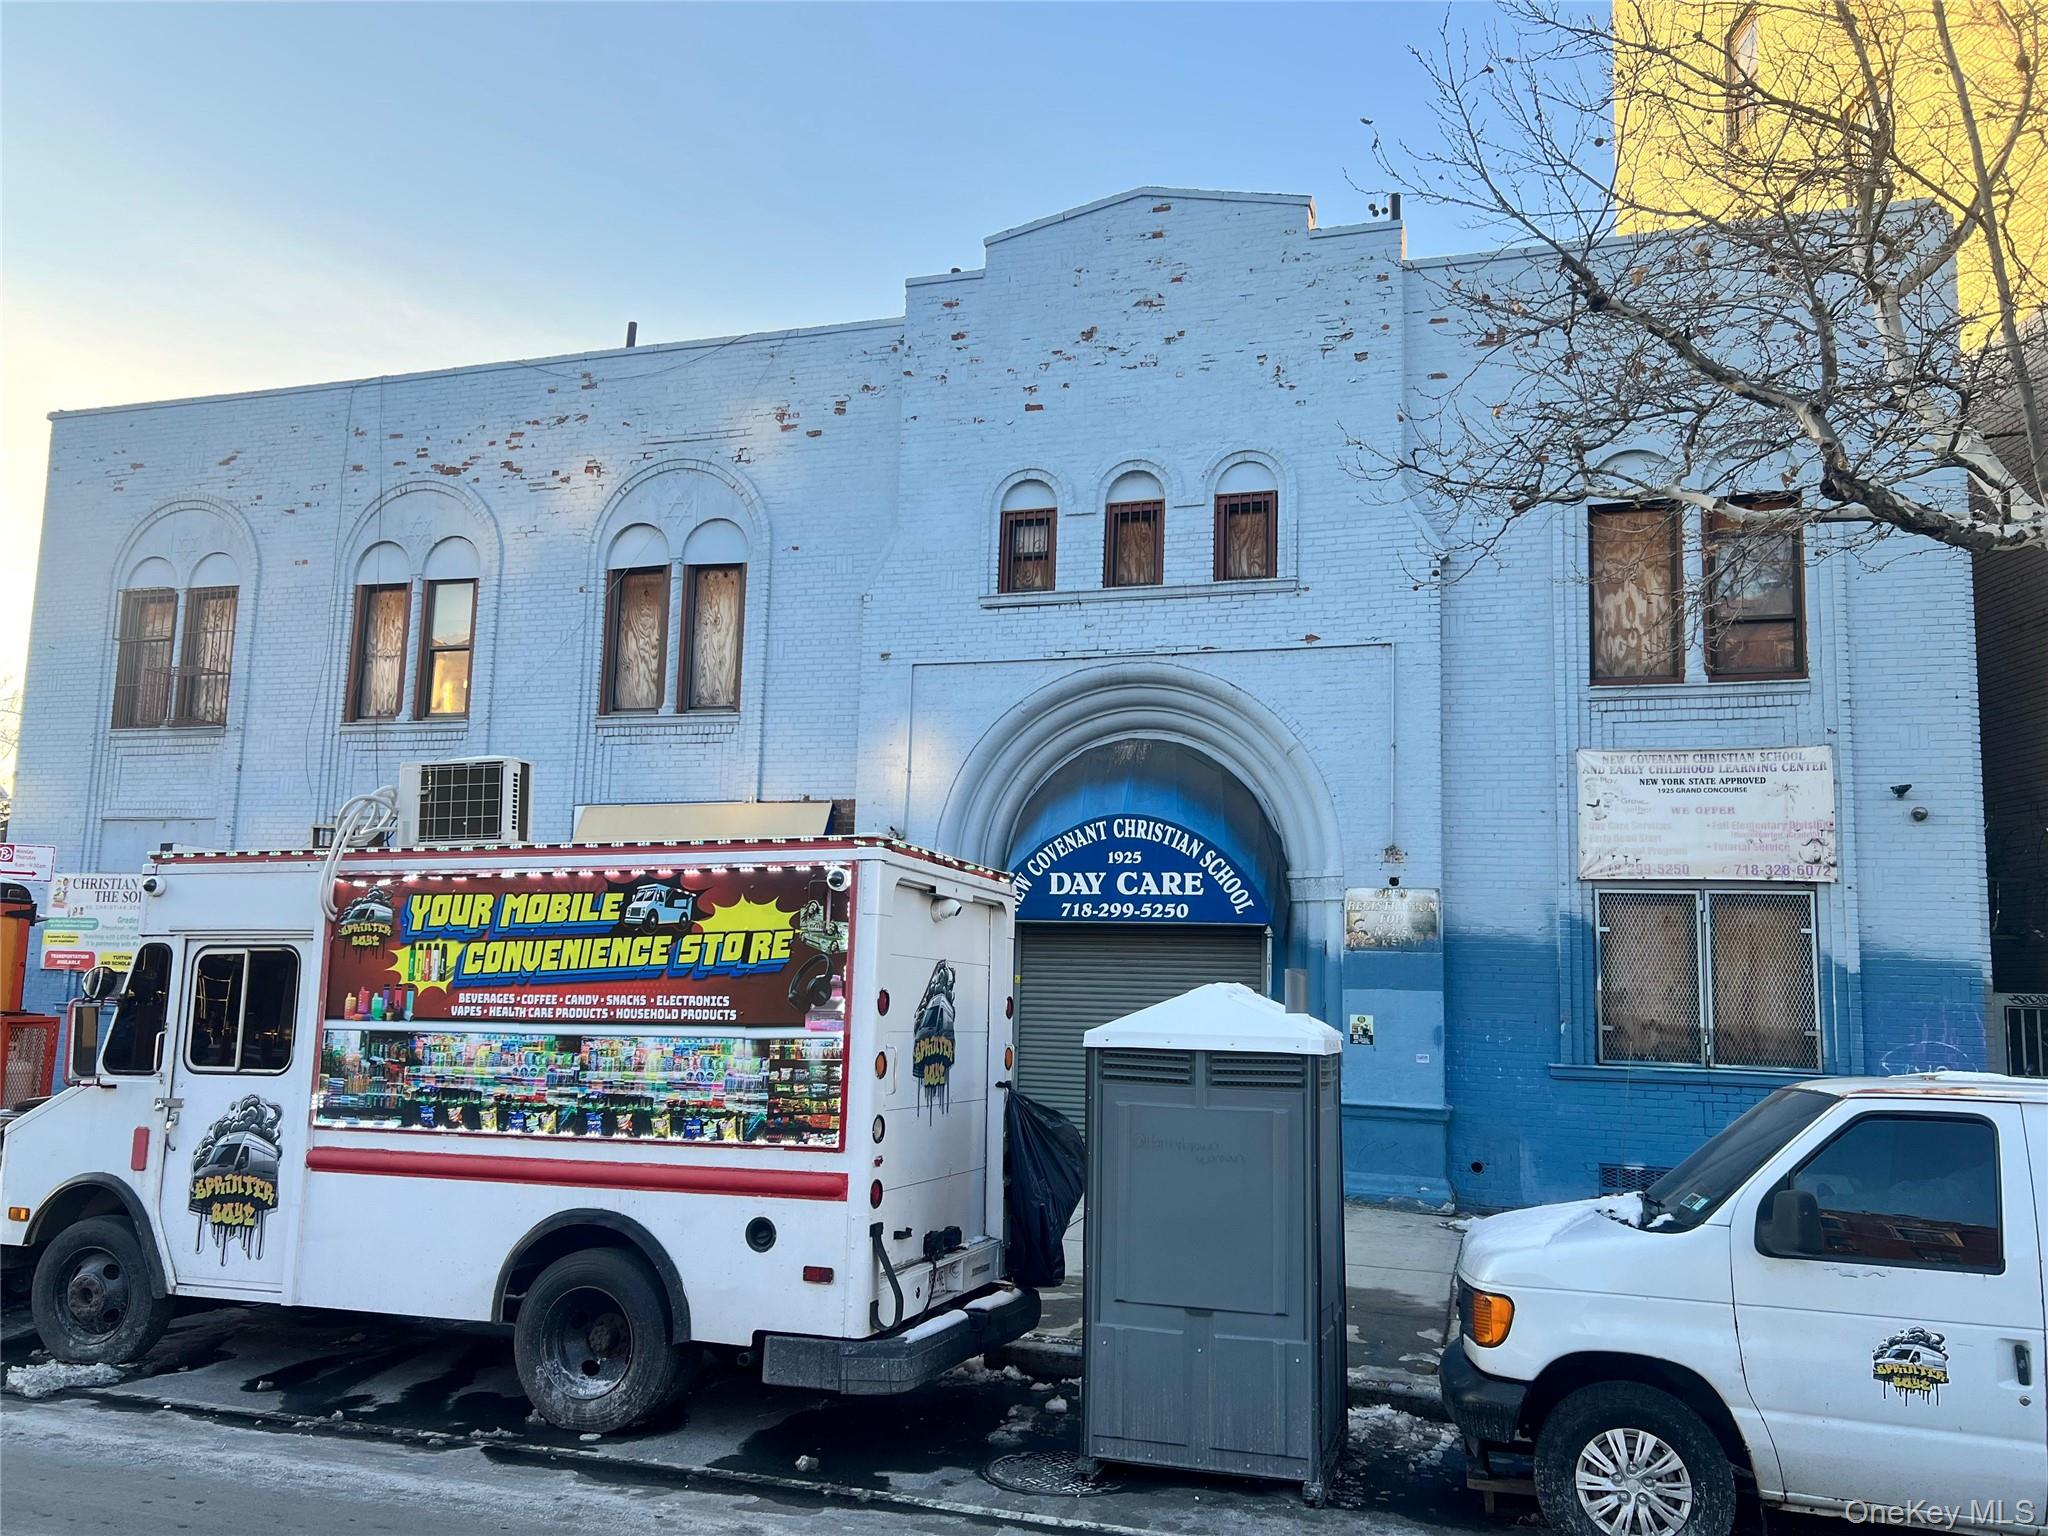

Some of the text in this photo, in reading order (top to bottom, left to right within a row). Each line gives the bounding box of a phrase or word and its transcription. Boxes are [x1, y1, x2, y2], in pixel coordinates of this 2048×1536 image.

[1602, 751, 1806, 764] NEW COVENANT CHRISTIAN SCHOOL
[1582, 761, 1828, 775] AND EARLY CHILDHOOD LEARNING CENTER
[1639, 776, 1767, 786] NEW YORK STATE APPROVED
[1703, 786, 1748, 794] CONCOURSE
[1671, 806, 1736, 815] WE OFFER
[1107, 851, 1142, 864] 1925
[1012, 818, 1256, 915] EW COVENANT CHRISTIAN SCHOOL
[1734, 864, 1832, 877] 718-328-6072
[73, 878, 139, 890] CHRISTIAN
[1050, 872, 1204, 895] DAY CARE
[95, 891, 119, 903] THE
[410, 892, 624, 931] YOUR MOBILE
[1061, 903, 1189, 918] 718-299-5250
[463, 935, 673, 974] CONVENIENCE
[458, 993, 730, 1007] BEVERAGES COFFEE CANDY SNACKS ELECTRONICS
[450, 1006, 737, 1020] VAPES HEALTH CARE PRODUCTS HOUSEHOLD PRODUCTS
